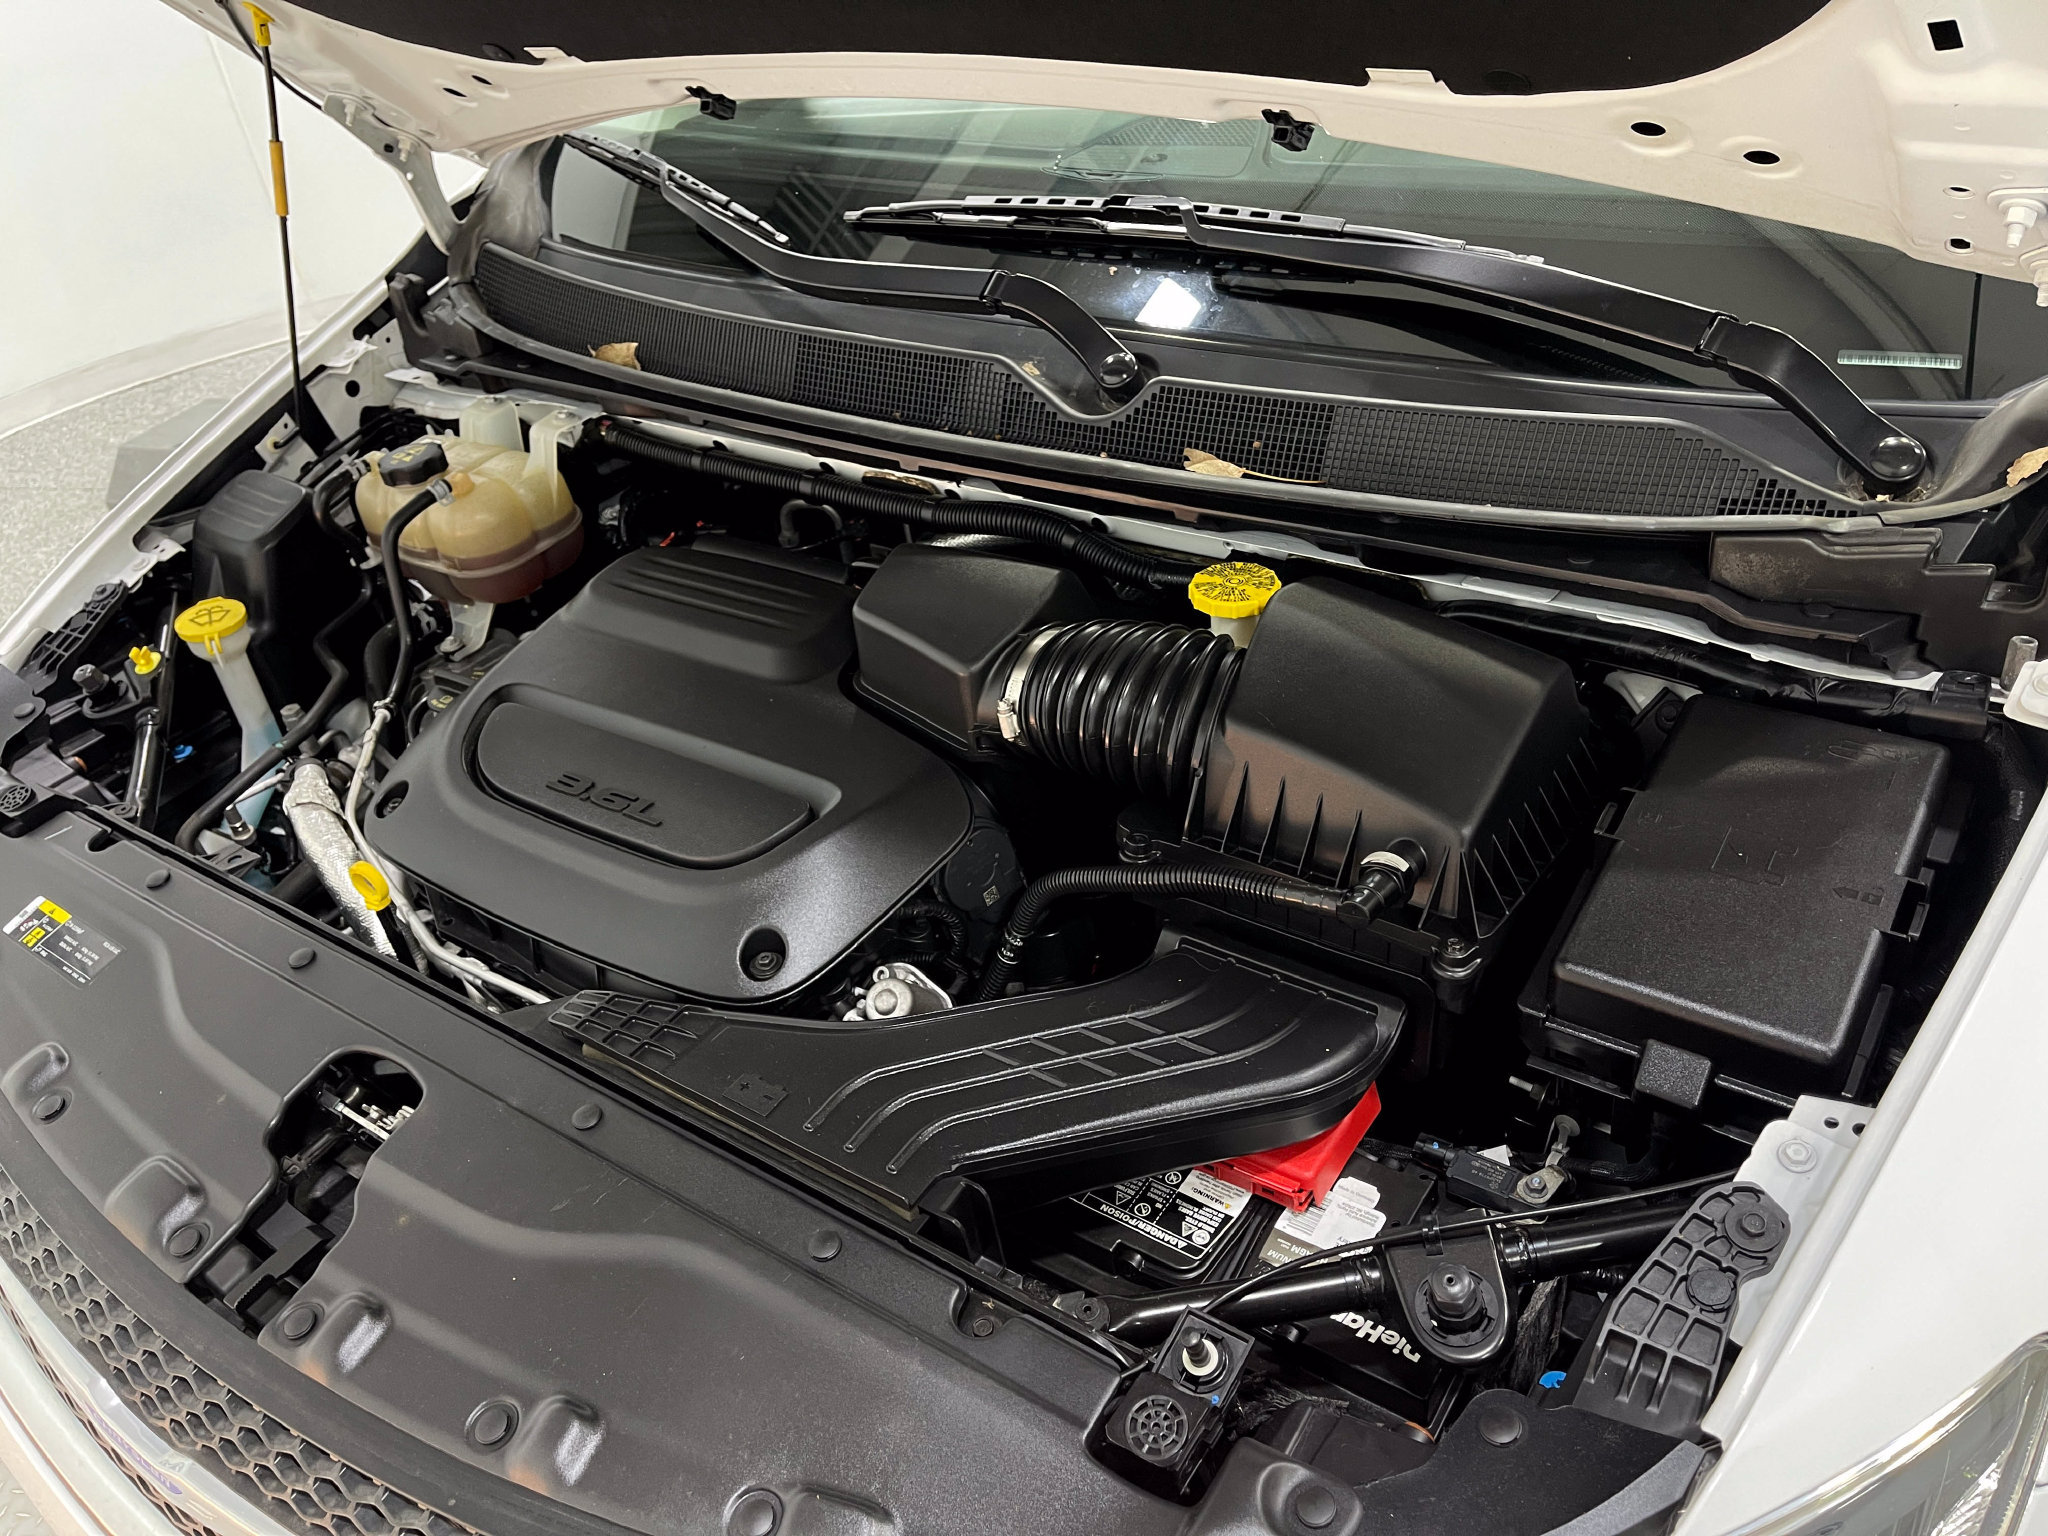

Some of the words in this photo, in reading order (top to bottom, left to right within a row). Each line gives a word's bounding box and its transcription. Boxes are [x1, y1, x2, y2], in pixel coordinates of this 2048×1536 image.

[545, 772, 664, 828] 3.6L
[1190, 1187, 1225, 1206] WARNING:
[1098, 1202, 1179, 1246] DANGER/POISON
